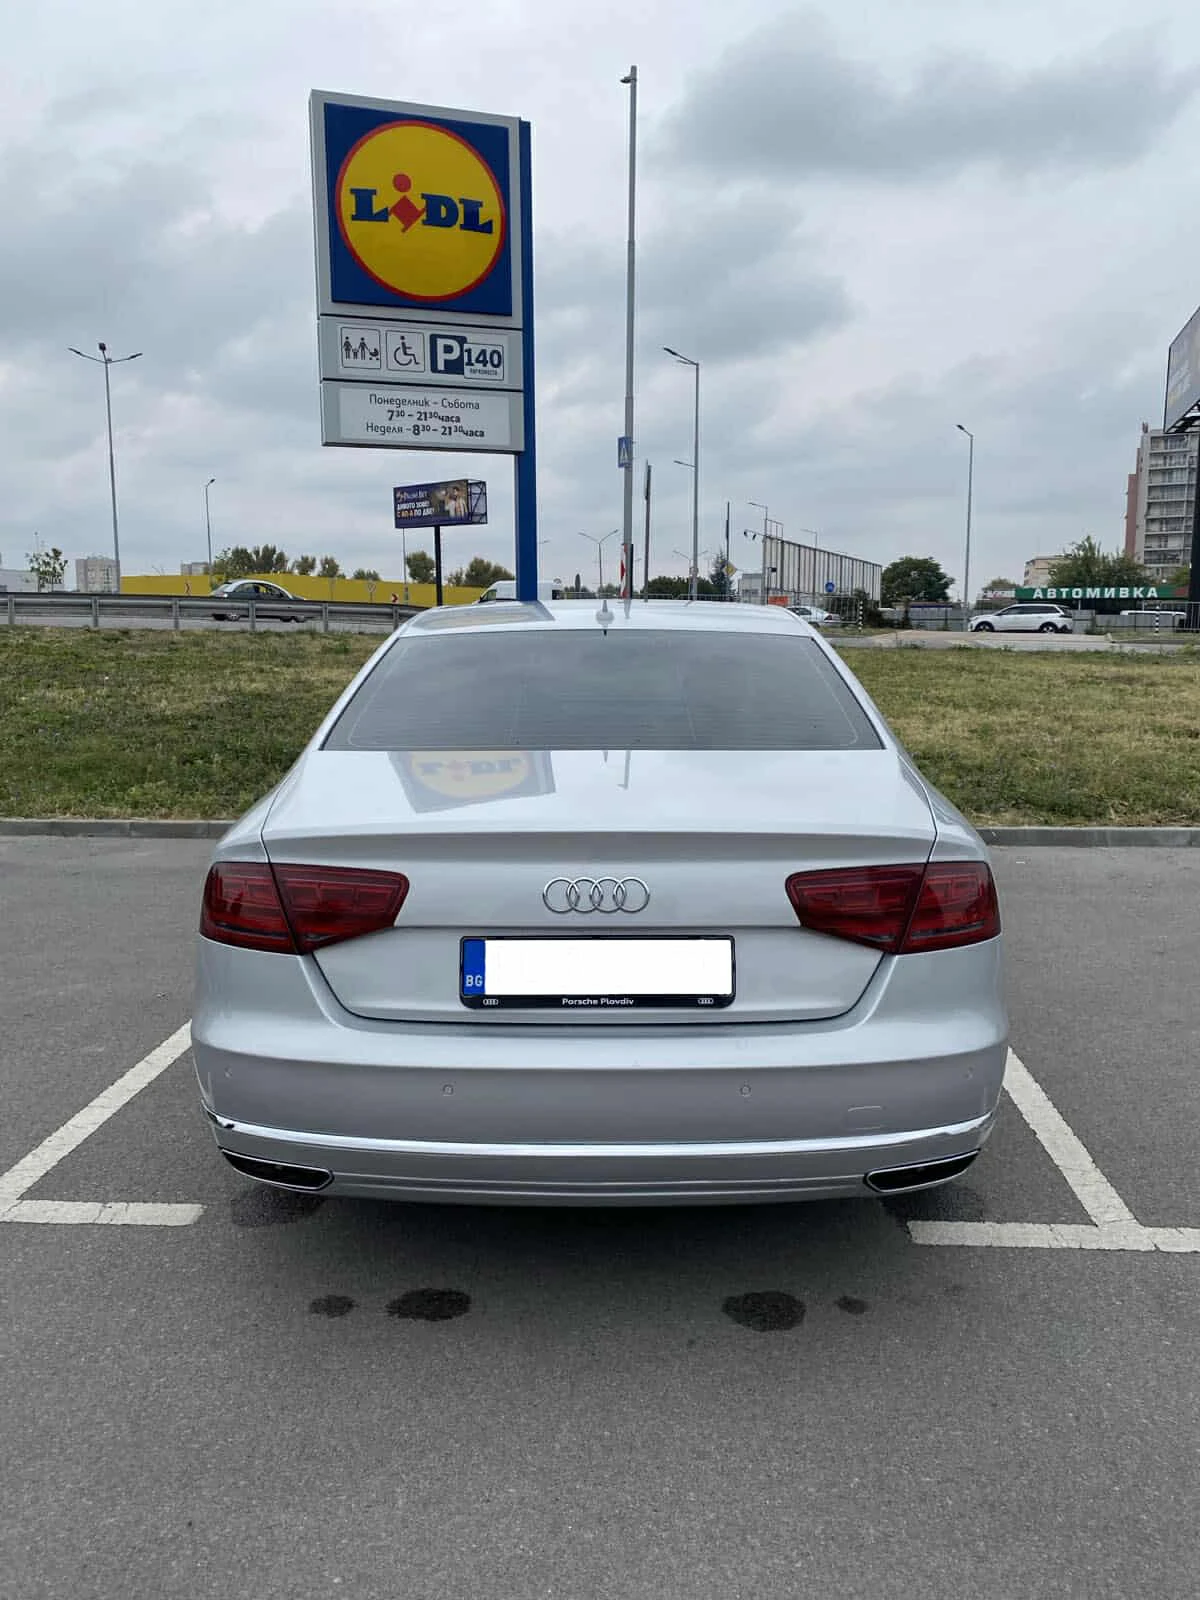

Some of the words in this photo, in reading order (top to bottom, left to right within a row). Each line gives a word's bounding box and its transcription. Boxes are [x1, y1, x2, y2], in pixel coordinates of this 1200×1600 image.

[436, 338, 461, 371] P
[464, 347, 502, 369] 140
[369, 393, 431, 408] Понеделник
[441, 397, 480, 410] Събота
[1032, 586, 1159, 600] АВТОМИВКА
[465, 975, 483, 987] BG
[562, 998, 599, 1006] Porsche
[600, 997, 635, 1006] Plovdiv
